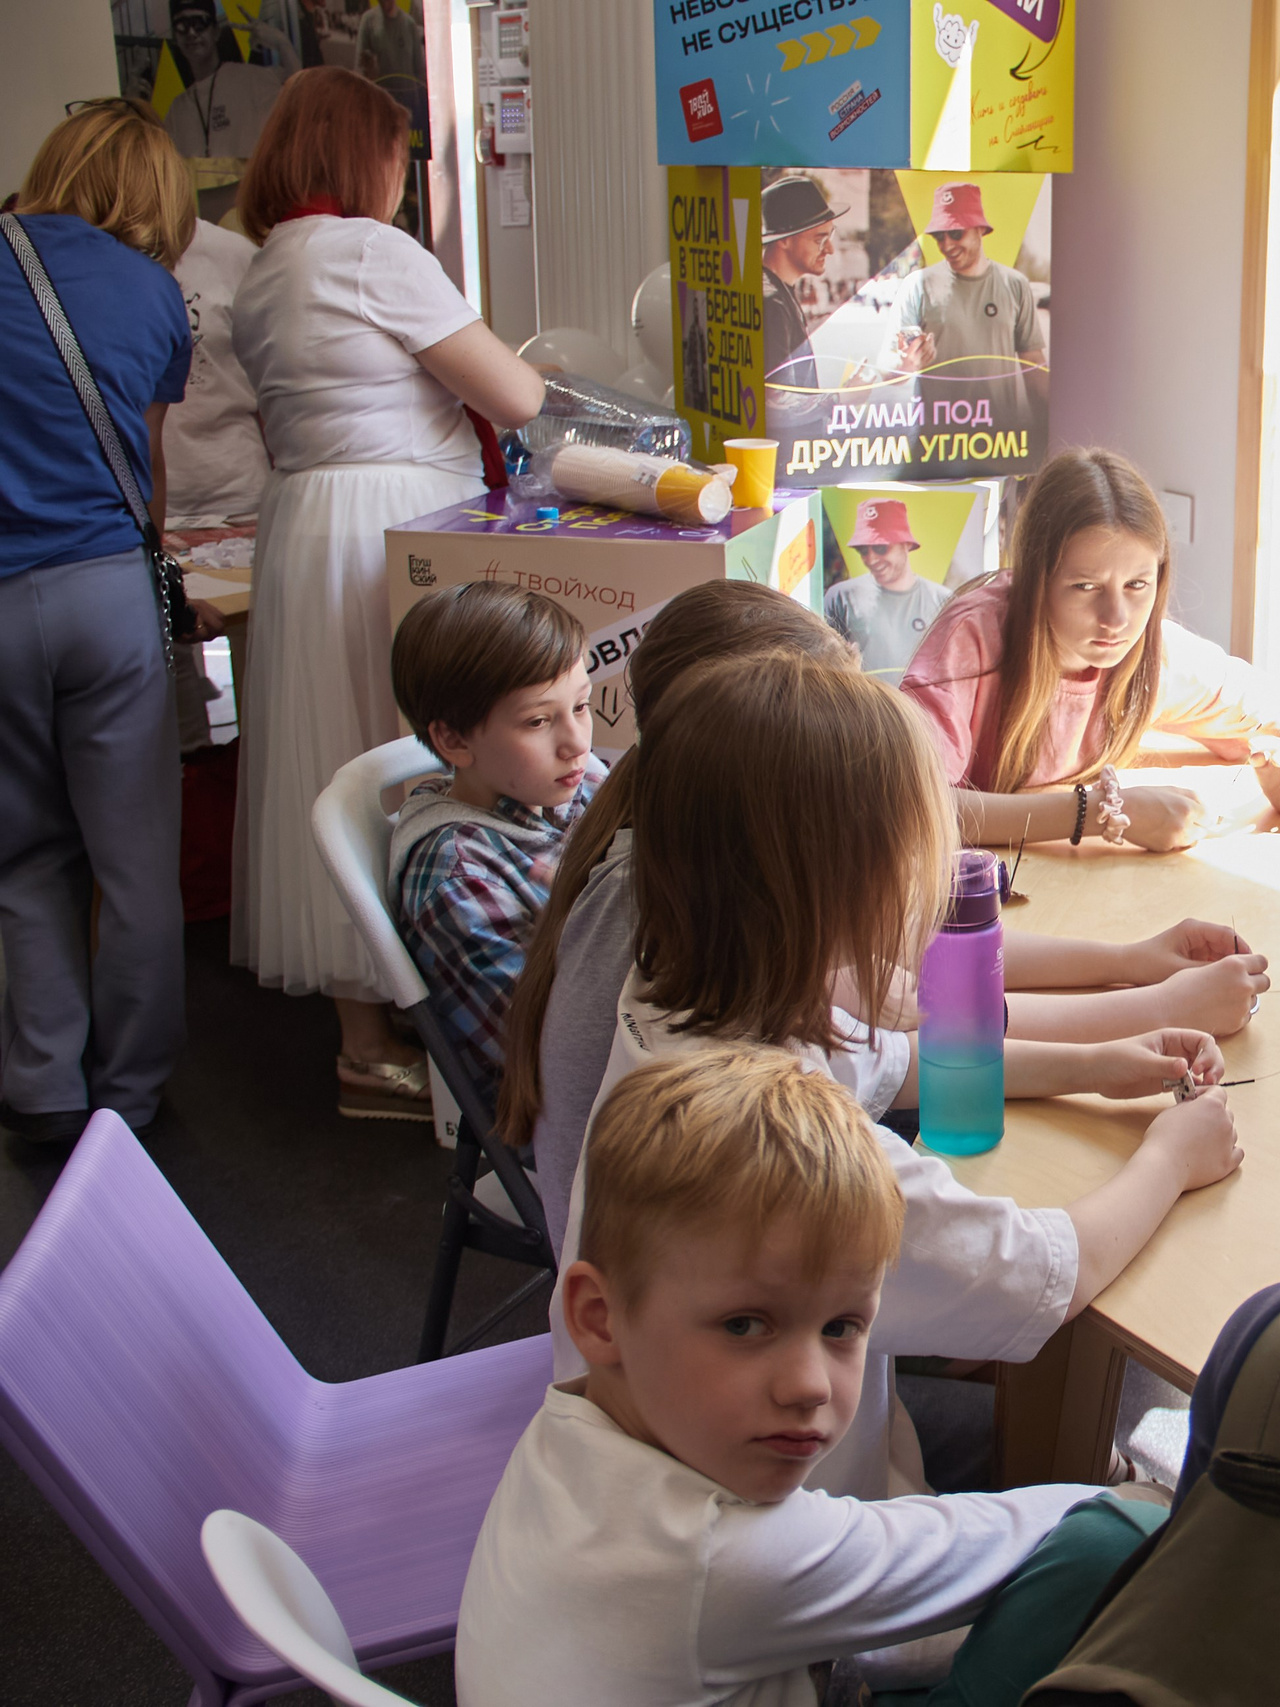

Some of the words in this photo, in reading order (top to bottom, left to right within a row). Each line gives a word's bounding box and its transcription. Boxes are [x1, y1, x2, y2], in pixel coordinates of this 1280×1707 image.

[681, 29, 713, 56] НЕ
[672, 195, 719, 244] СИЛА
[679, 246, 687, 280] В
[689, 247, 721, 285] ТЕБЕ
[706, 287, 762, 331] БЕРЕШЬ
[719, 330, 754, 369] ДЕЛА
[709, 364, 757, 432] ЕШЬ
[826, 396, 925, 434] ДУМАЙ
[933, 399, 993, 428] ПОД
[786, 435, 912, 475] ДРУГИМ
[919, 430, 1028, 463] УГЛОМ!
[411, 558, 431, 567] ПУШ
